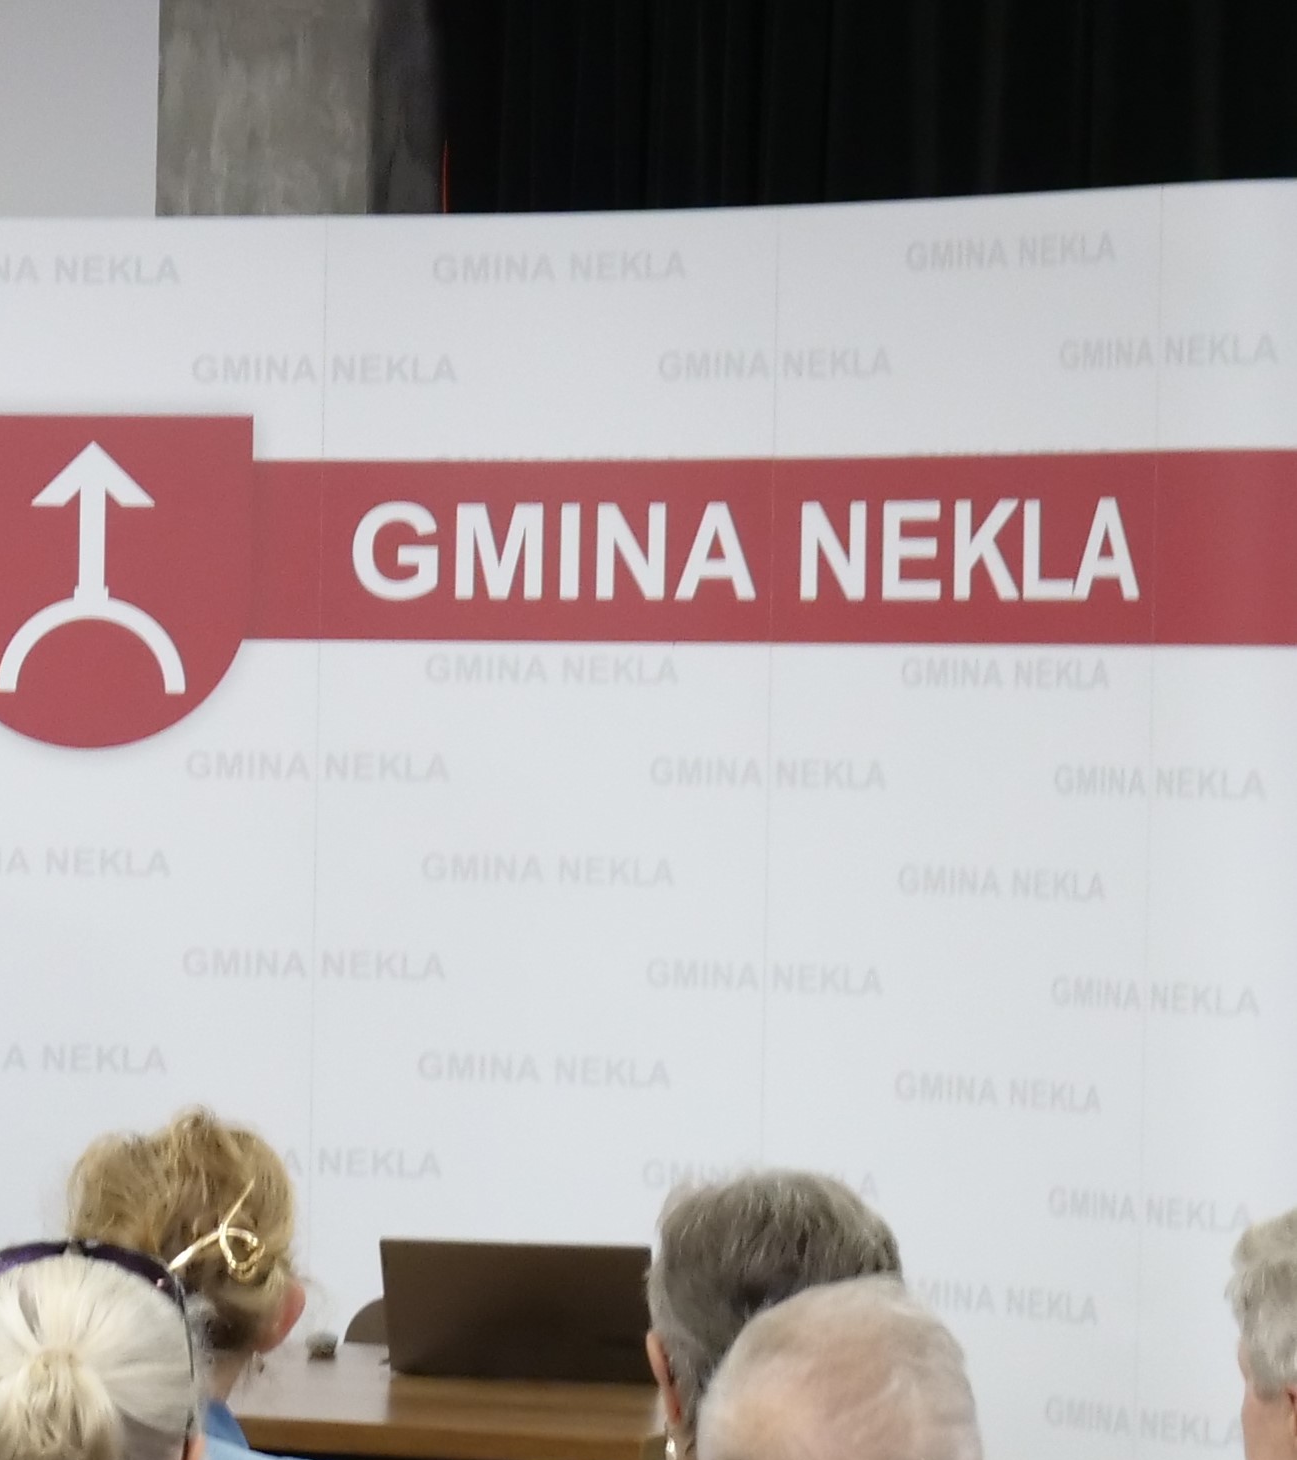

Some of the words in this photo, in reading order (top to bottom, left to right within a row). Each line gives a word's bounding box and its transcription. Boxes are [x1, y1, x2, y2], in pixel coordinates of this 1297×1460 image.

[433, 254, 554, 285] GMINA
[571, 251, 685, 282] NEKLA
[907, 238, 1007, 271] GMINA
[1018, 232, 1114, 267] NEKLA
[55, 255, 179, 284] NEKLA
[659, 350, 769, 381] GMINA
[783, 347, 891, 379] NEKLA
[1060, 337, 1153, 370] GMINA
[1165, 333, 1277, 367] NEKLA
[192, 355, 316, 383] GMINA
[331, 355, 457, 384] NEKLA
[353, 500, 755, 602] GMINA
[800, 497, 1140, 602] NEKLA
[426, 655, 547, 685] GMINA
[562, 655, 678, 685] NEKLA
[901, 657, 1003, 687] GMINA
[1014, 658, 1109, 690] NEKLA
[186, 752, 309, 780] GMINA
[325, 752, 448, 782] NEKLA
[650, 758, 761, 787] GMINA
[776, 760, 886, 790] NEKLA
[1054, 764, 1146, 796] GMINA
[1155, 766, 1266, 800] NEKLA
[46, 848, 170, 877] NEKLA
[422, 855, 542, 885] GMINA
[558, 856, 674, 888] NEKLA
[898, 864, 1000, 898] GMINA
[1011, 869, 1105, 902] NEKLA
[183, 949, 306, 978] GMINA
[321, 950, 445, 980] NEKLA
[646, 958, 759, 990] GMINA
[772, 962, 882, 995] NEKLA
[1052, 977, 1141, 1010] GMINA
[1151, 982, 1259, 1017] NEKLA
[42, 1044, 166, 1073] NEKLA
[418, 1052, 538, 1083] GMINA
[555, 1055, 670, 1089] NEKLA
[895, 1071, 997, 1106] GMINA
[1008, 1078, 1100, 1113] NEKLA
[319, 1149, 440, 1178] NEKLA
[1048, 1185, 1136, 1223] GMINA
[917, 1280, 995, 1315] MINA
[1007, 1289, 1097, 1324] NEKLA
[1045, 1397, 1133, 1435] GMINA
